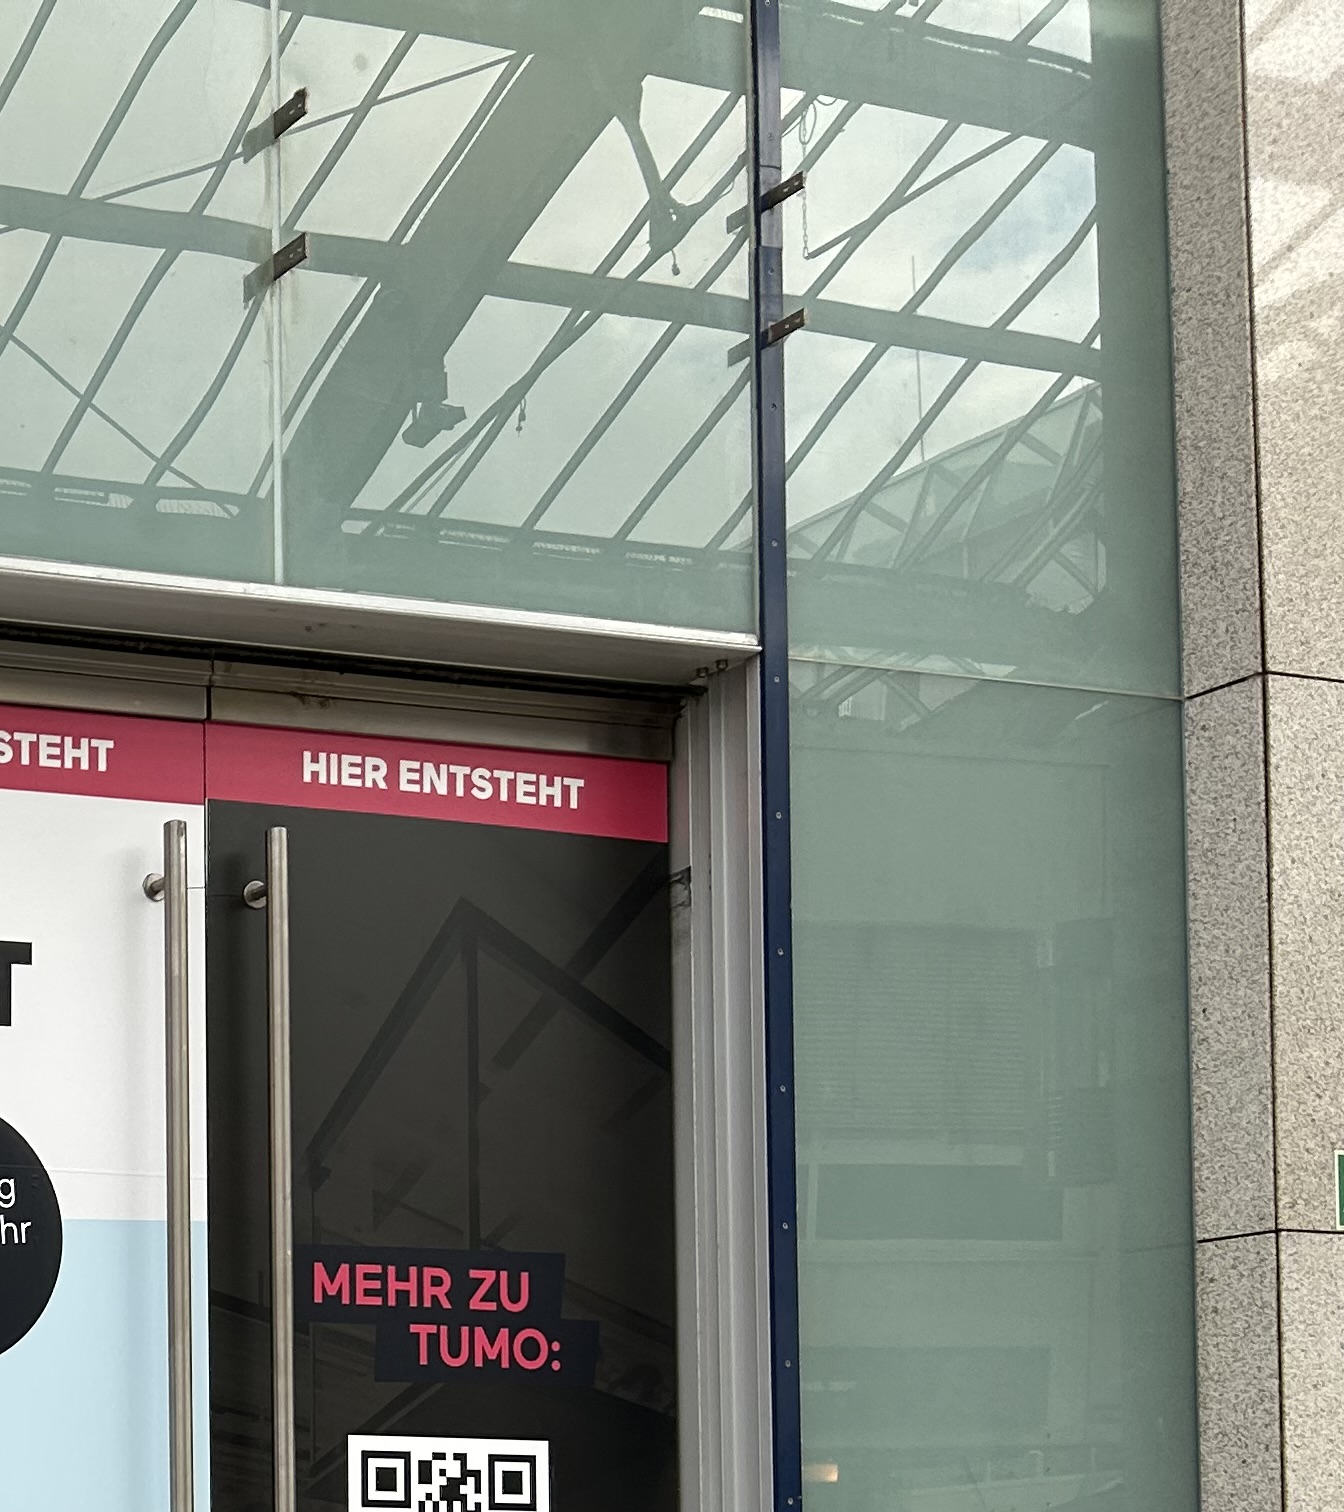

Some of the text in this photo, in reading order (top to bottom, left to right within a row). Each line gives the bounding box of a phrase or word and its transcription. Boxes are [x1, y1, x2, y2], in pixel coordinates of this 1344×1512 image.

[302, 750, 585, 810] HIER ENTSTEHT
[313, 1262, 529, 1313] MEHR ZU
[409, 1323, 561, 1371] TUMO:
